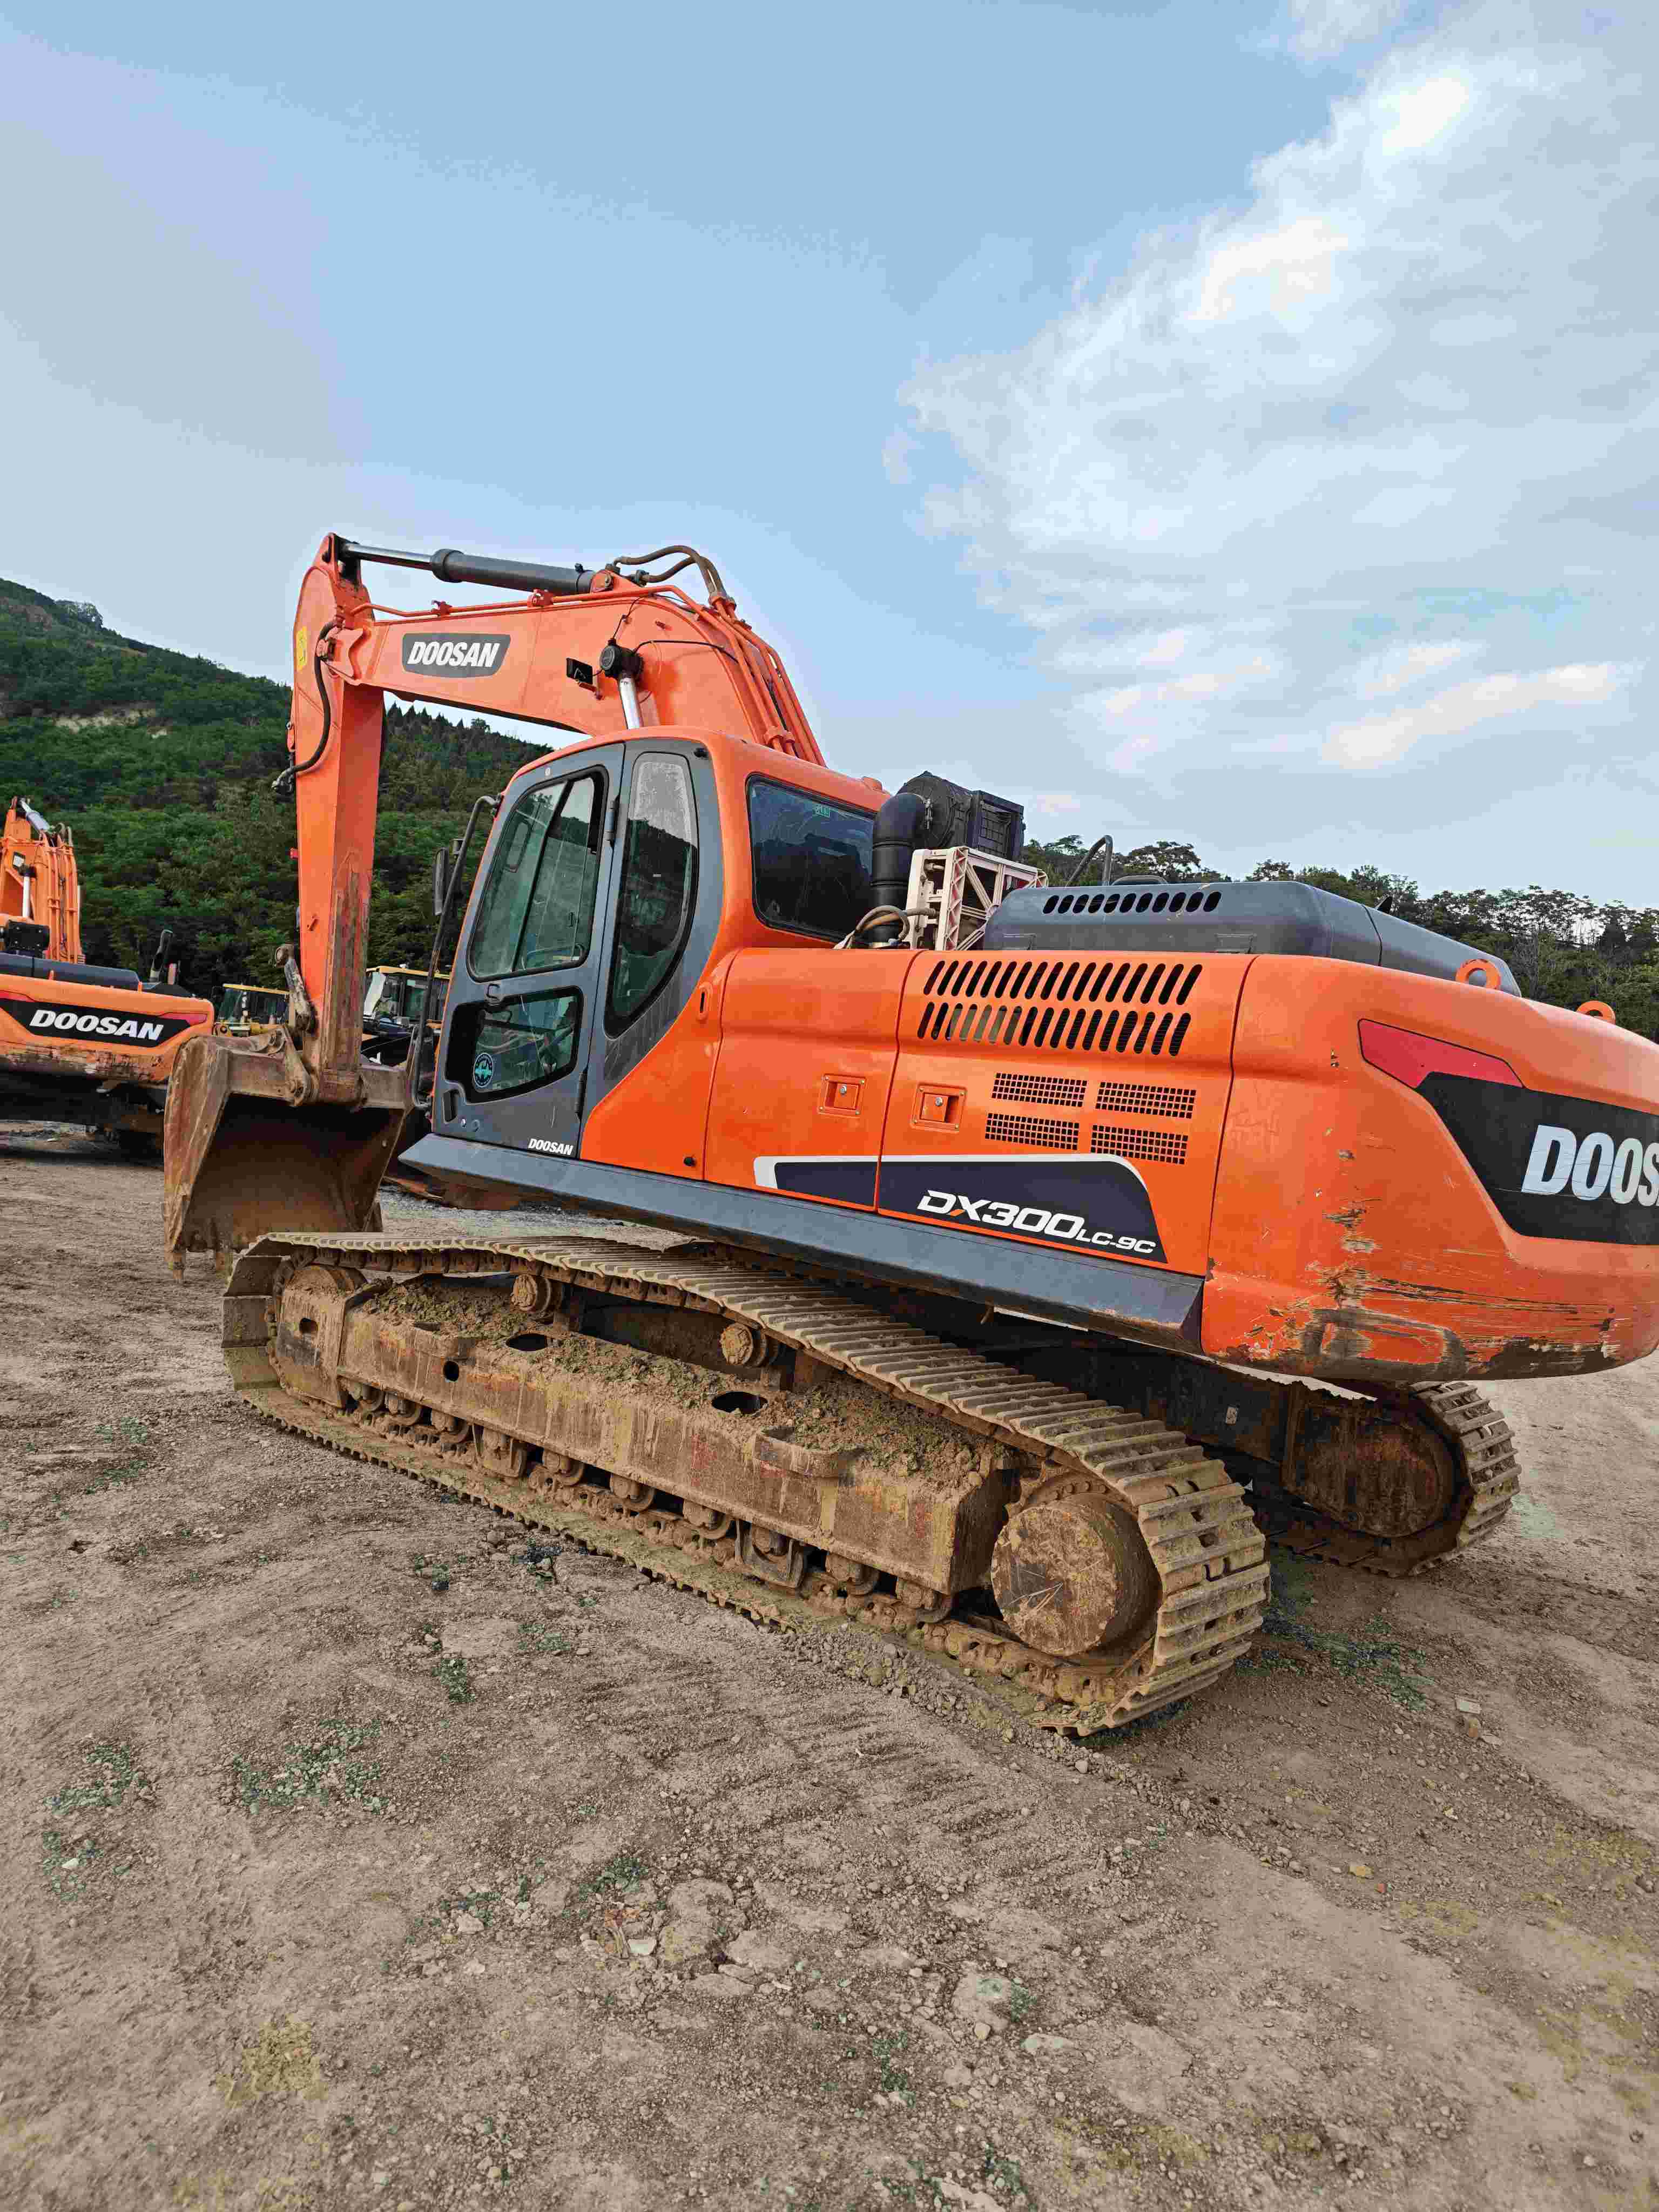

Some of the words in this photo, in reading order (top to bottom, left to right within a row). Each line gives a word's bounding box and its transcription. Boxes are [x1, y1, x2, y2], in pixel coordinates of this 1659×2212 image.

[407, 641, 500, 667] DOOSAN
[29, 1009, 164, 1040] DOOSAN
[528, 1138, 574, 1156] DOOSAN
[1521, 1124, 1659, 1206] DOOS
